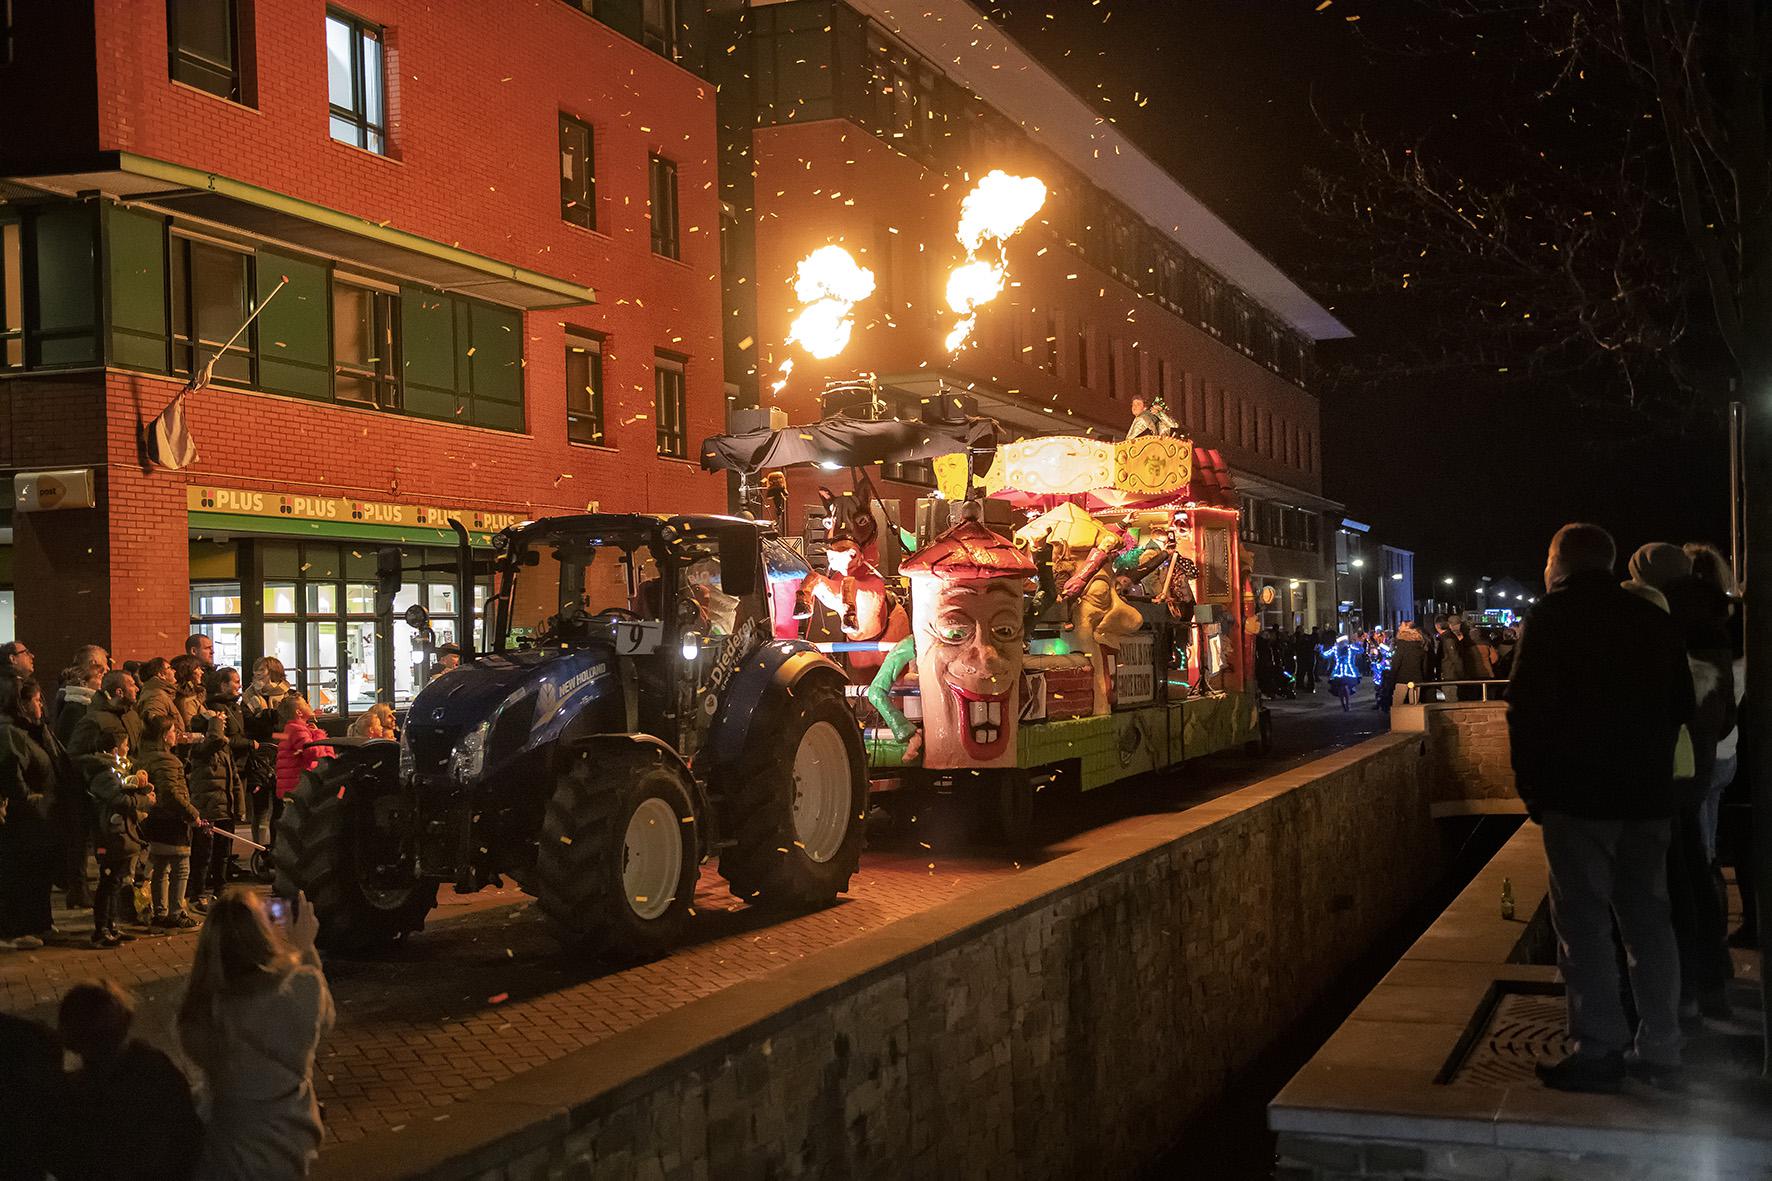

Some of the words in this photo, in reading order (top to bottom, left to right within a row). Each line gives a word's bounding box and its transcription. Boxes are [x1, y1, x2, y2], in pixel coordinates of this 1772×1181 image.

[40, 487, 57, 497] post
[216, 490, 264, 511] PLUS
[294, 498, 336, 517] PLUS
[363, 504, 402, 522] PLUS
[628, 624, 643, 653] 9
[711, 616, 756, 685] Diederen
[559, 677, 576, 697] NEW
[576, 663, 606, 685] HOLLAND
